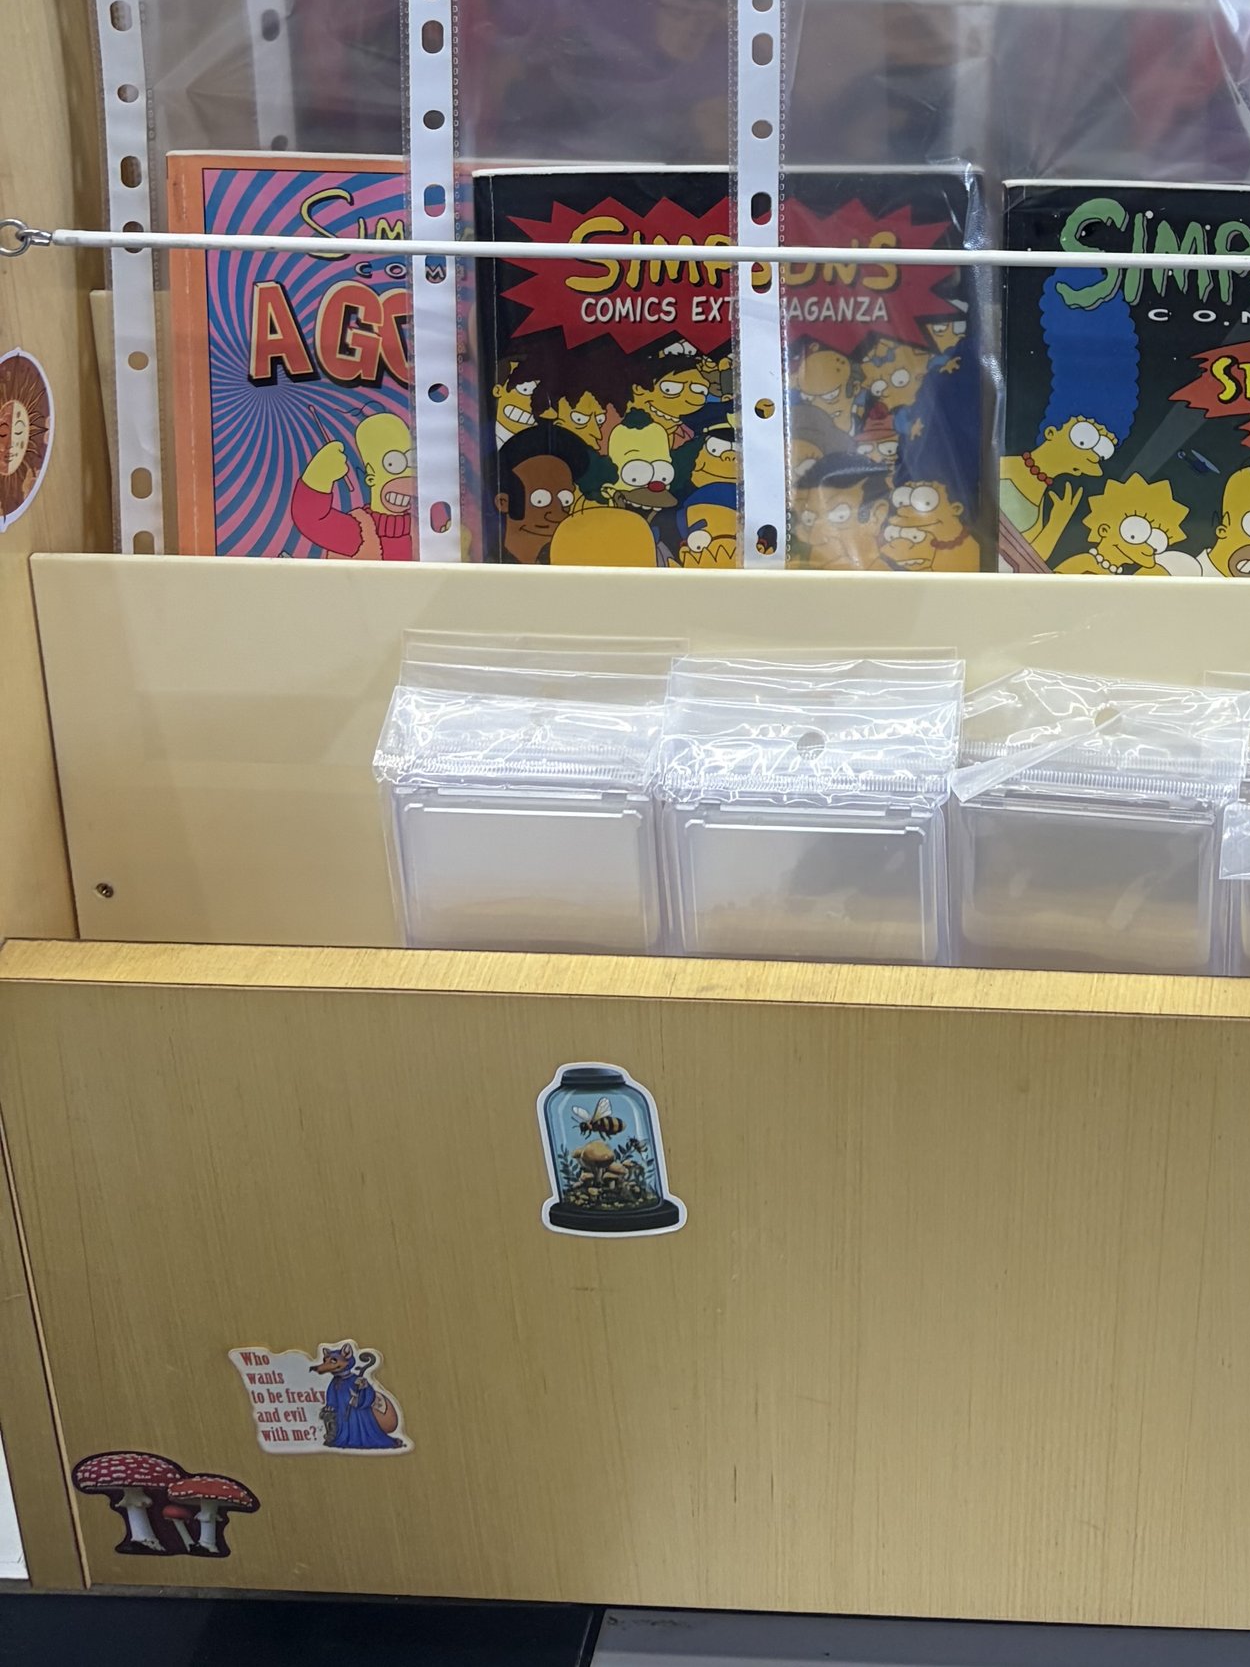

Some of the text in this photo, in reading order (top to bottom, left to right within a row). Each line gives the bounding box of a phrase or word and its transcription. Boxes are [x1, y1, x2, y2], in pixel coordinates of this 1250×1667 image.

[581, 296, 676, 323] COMICS
[239, 1352, 270, 1366] Who
[247, 1370, 285, 1385] wants
[251, 1388, 326, 1405] to be freaky
[257, 1407, 307, 1423] and evil
[261, 1426, 318, 1442] with me?
